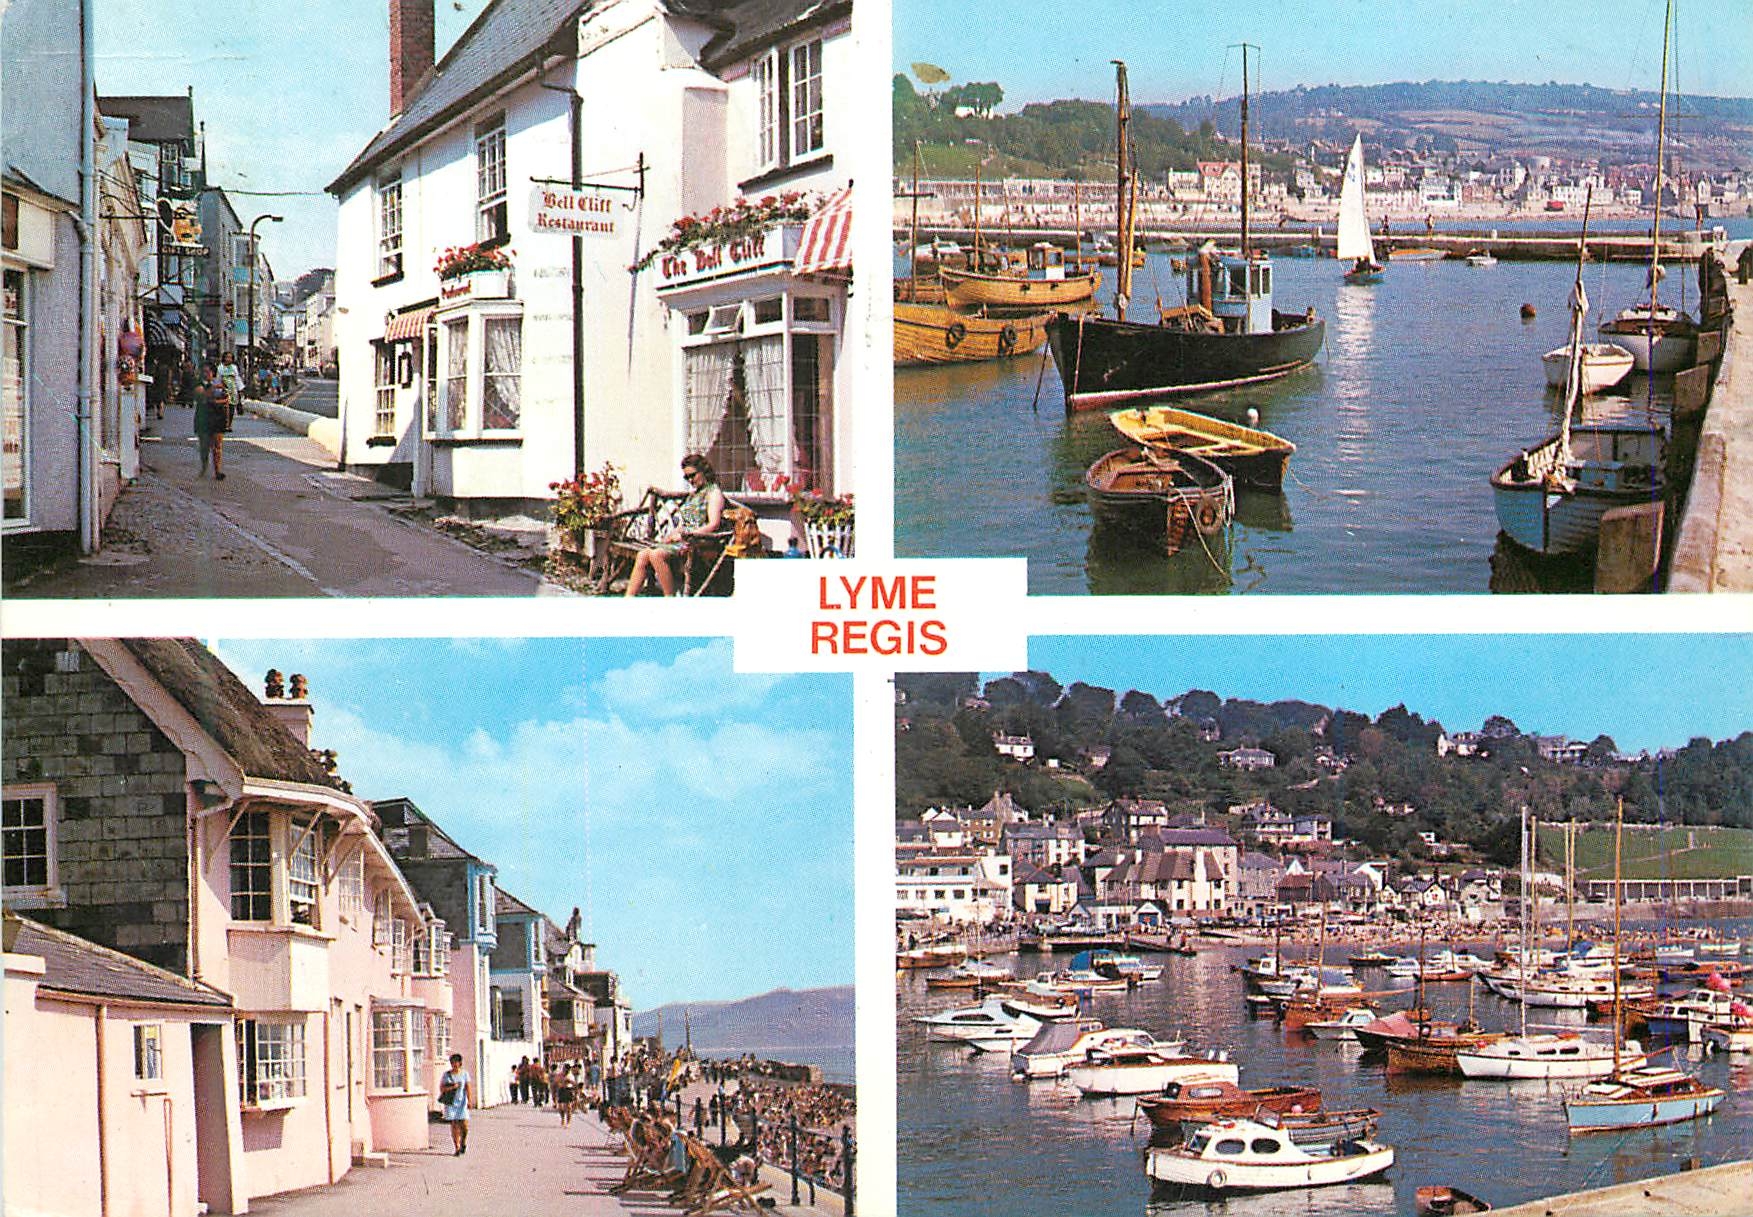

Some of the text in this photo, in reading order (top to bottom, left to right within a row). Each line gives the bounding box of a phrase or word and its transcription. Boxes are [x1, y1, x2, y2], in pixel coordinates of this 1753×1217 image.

[543, 192, 612, 213] Bell Cliff
[538, 213, 615, 232] Restaurant
[662, 255, 687, 279] The
[692, 244, 722, 272] Bell
